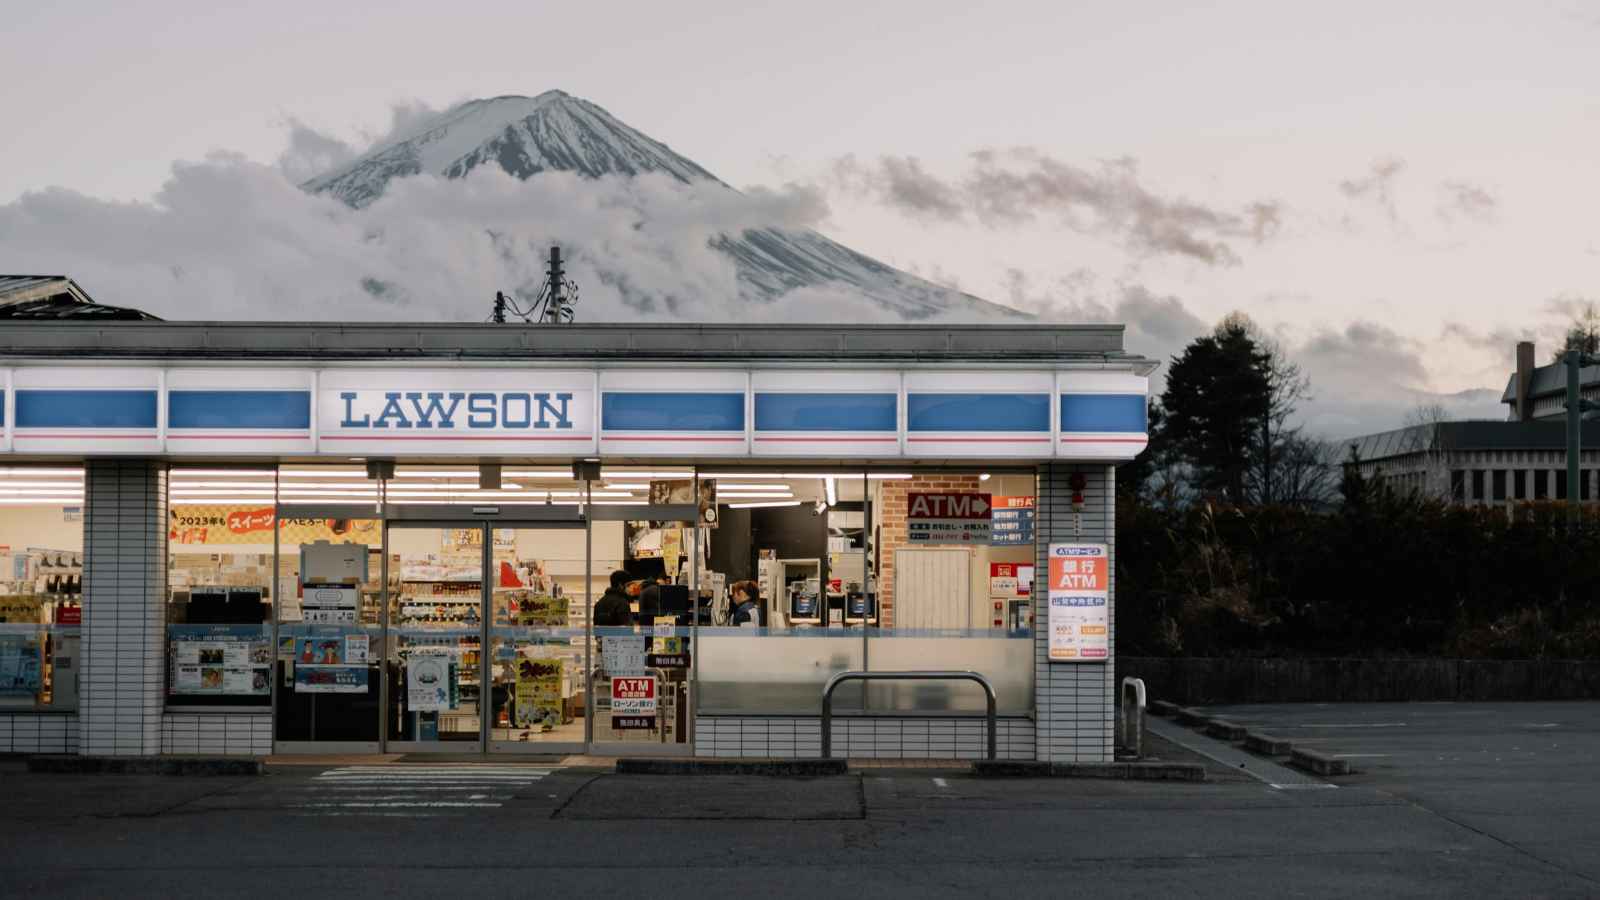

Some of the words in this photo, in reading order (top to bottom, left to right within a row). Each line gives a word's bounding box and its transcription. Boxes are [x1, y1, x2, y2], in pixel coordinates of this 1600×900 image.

[340, 391, 573, 429] LAWSON
[910, 495, 970, 516] ATM
[180, 516, 226, 527] 2023年も
[230, 513, 274, 529] スイーツ
[1063, 559, 1094, 573] 銀行
[1059, 574, 1097, 588] ATM
[618, 680, 648, 691] ATM
